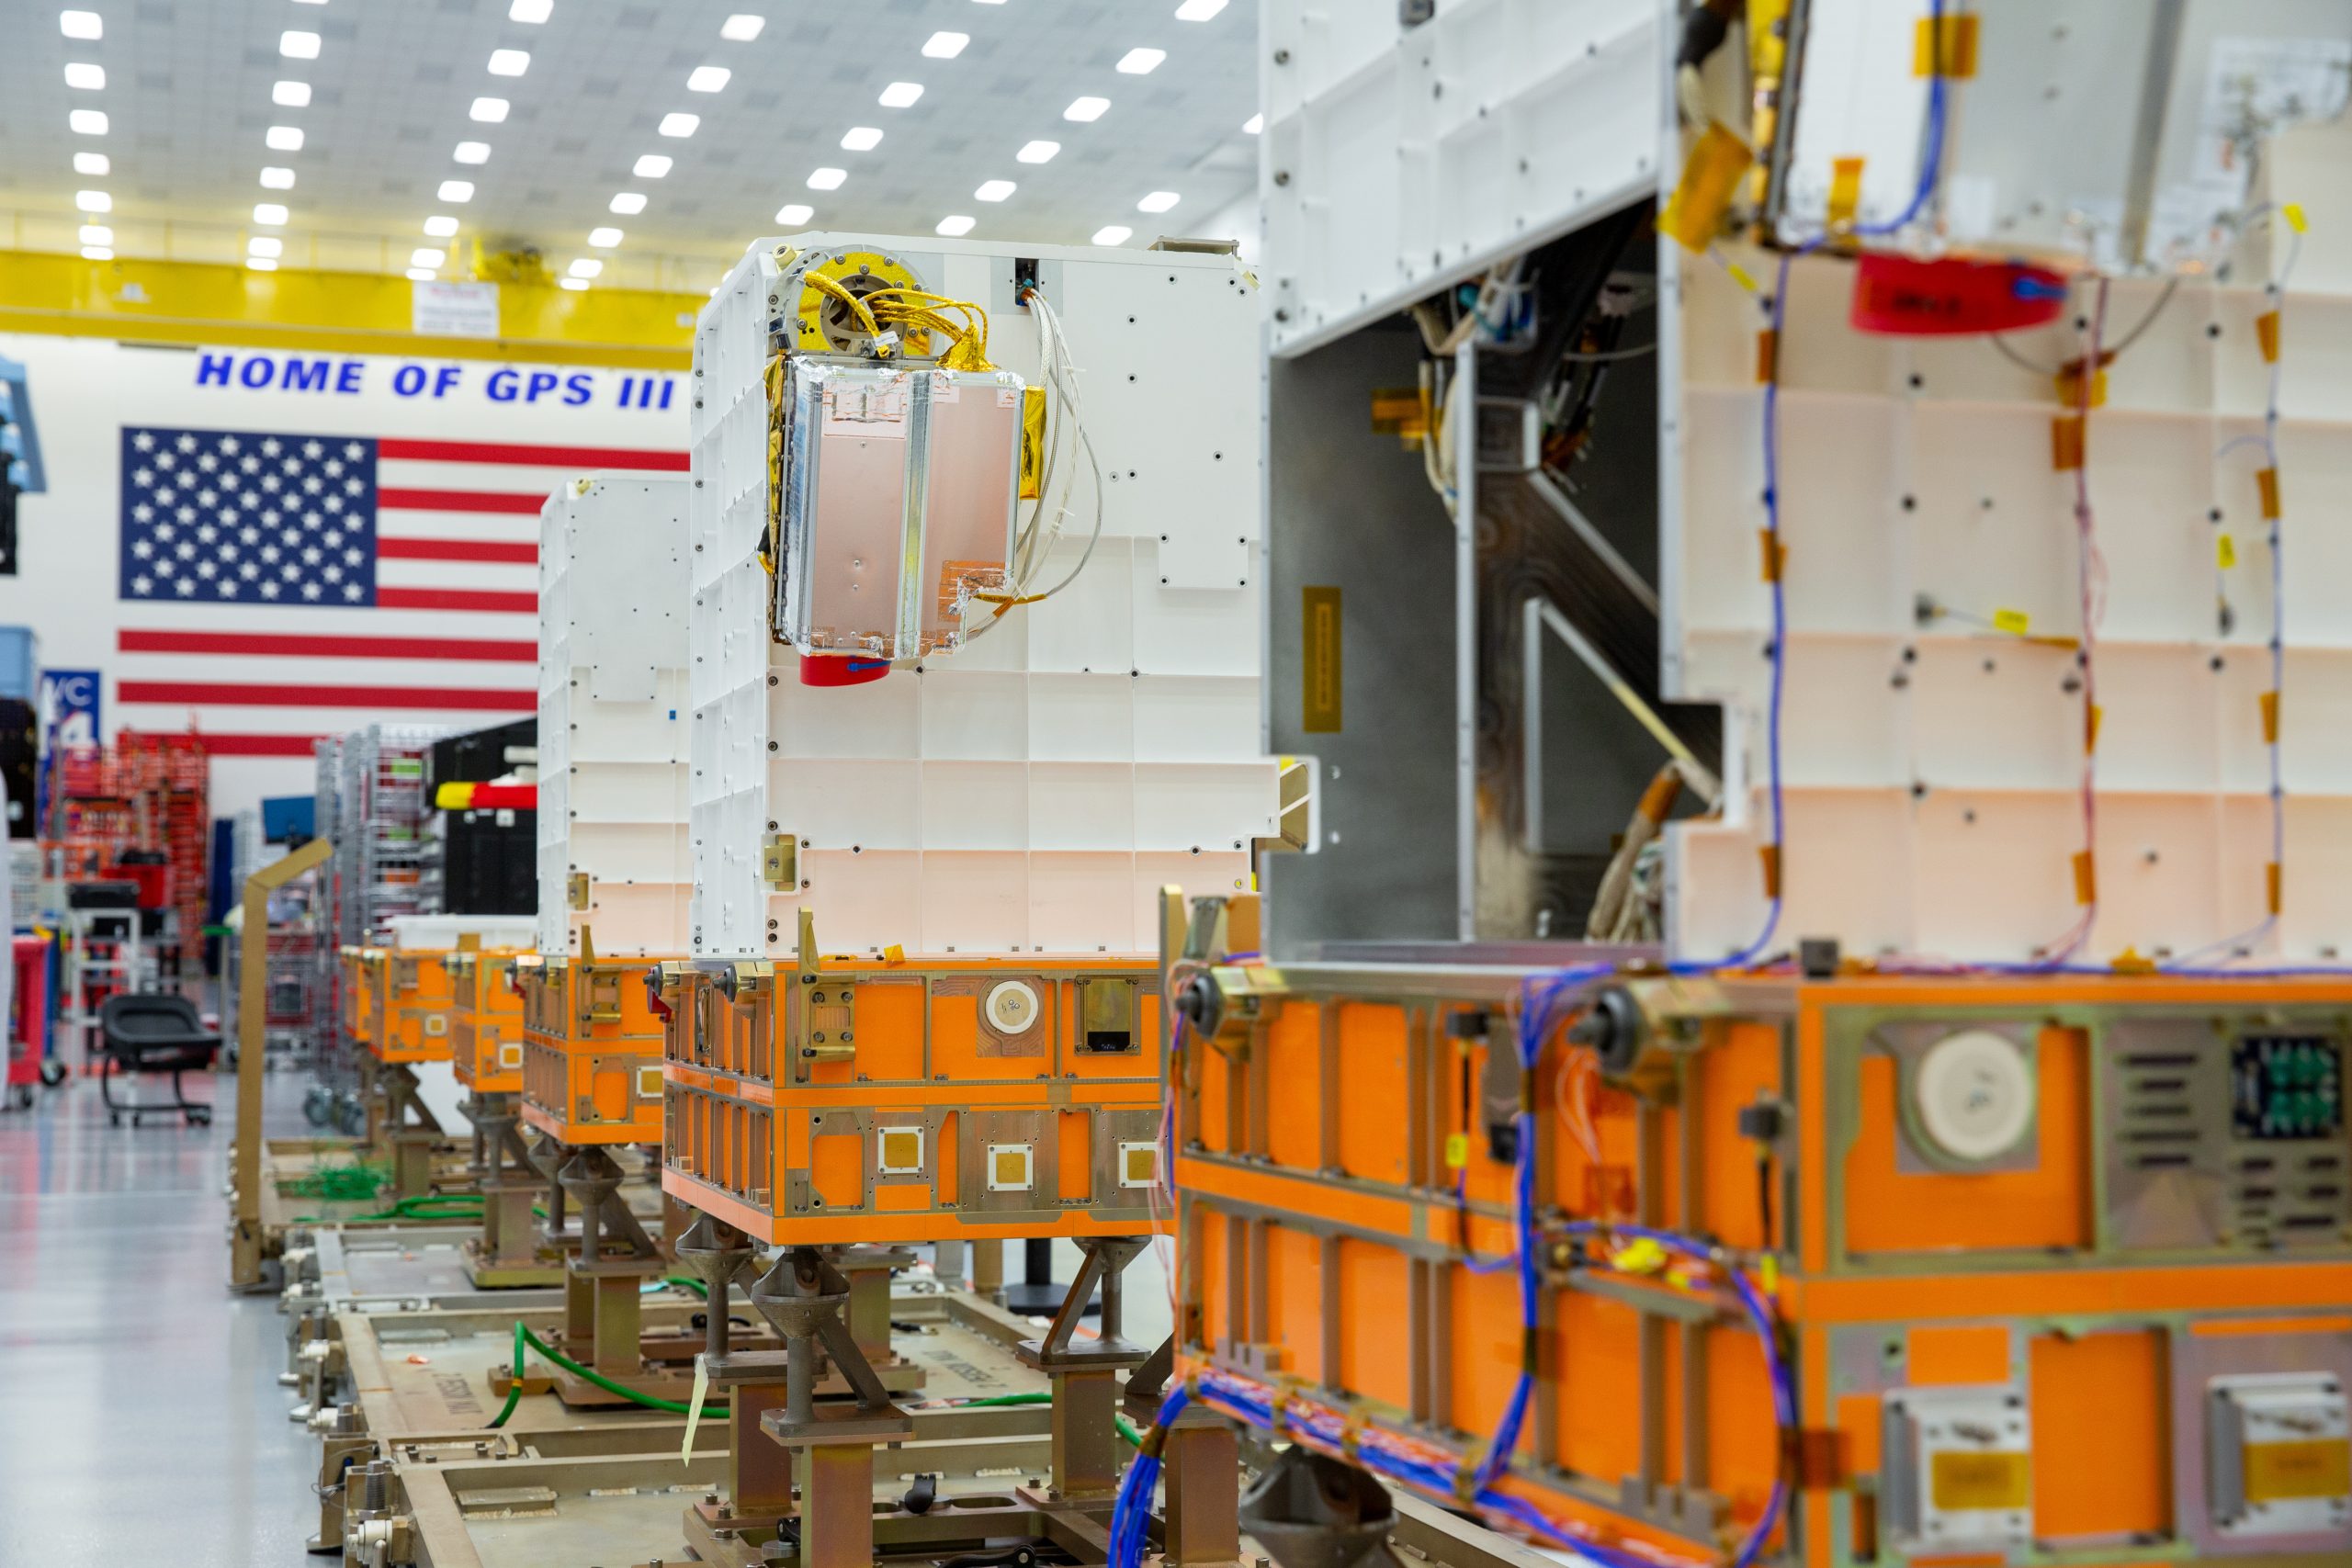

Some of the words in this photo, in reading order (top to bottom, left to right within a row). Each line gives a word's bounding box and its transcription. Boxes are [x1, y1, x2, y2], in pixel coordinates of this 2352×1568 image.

[196, 353, 366, 395] HOME
[392, 364, 462, 399] OF
[485, 368, 594, 407] GPS
[616, 377, 675, 411] III
